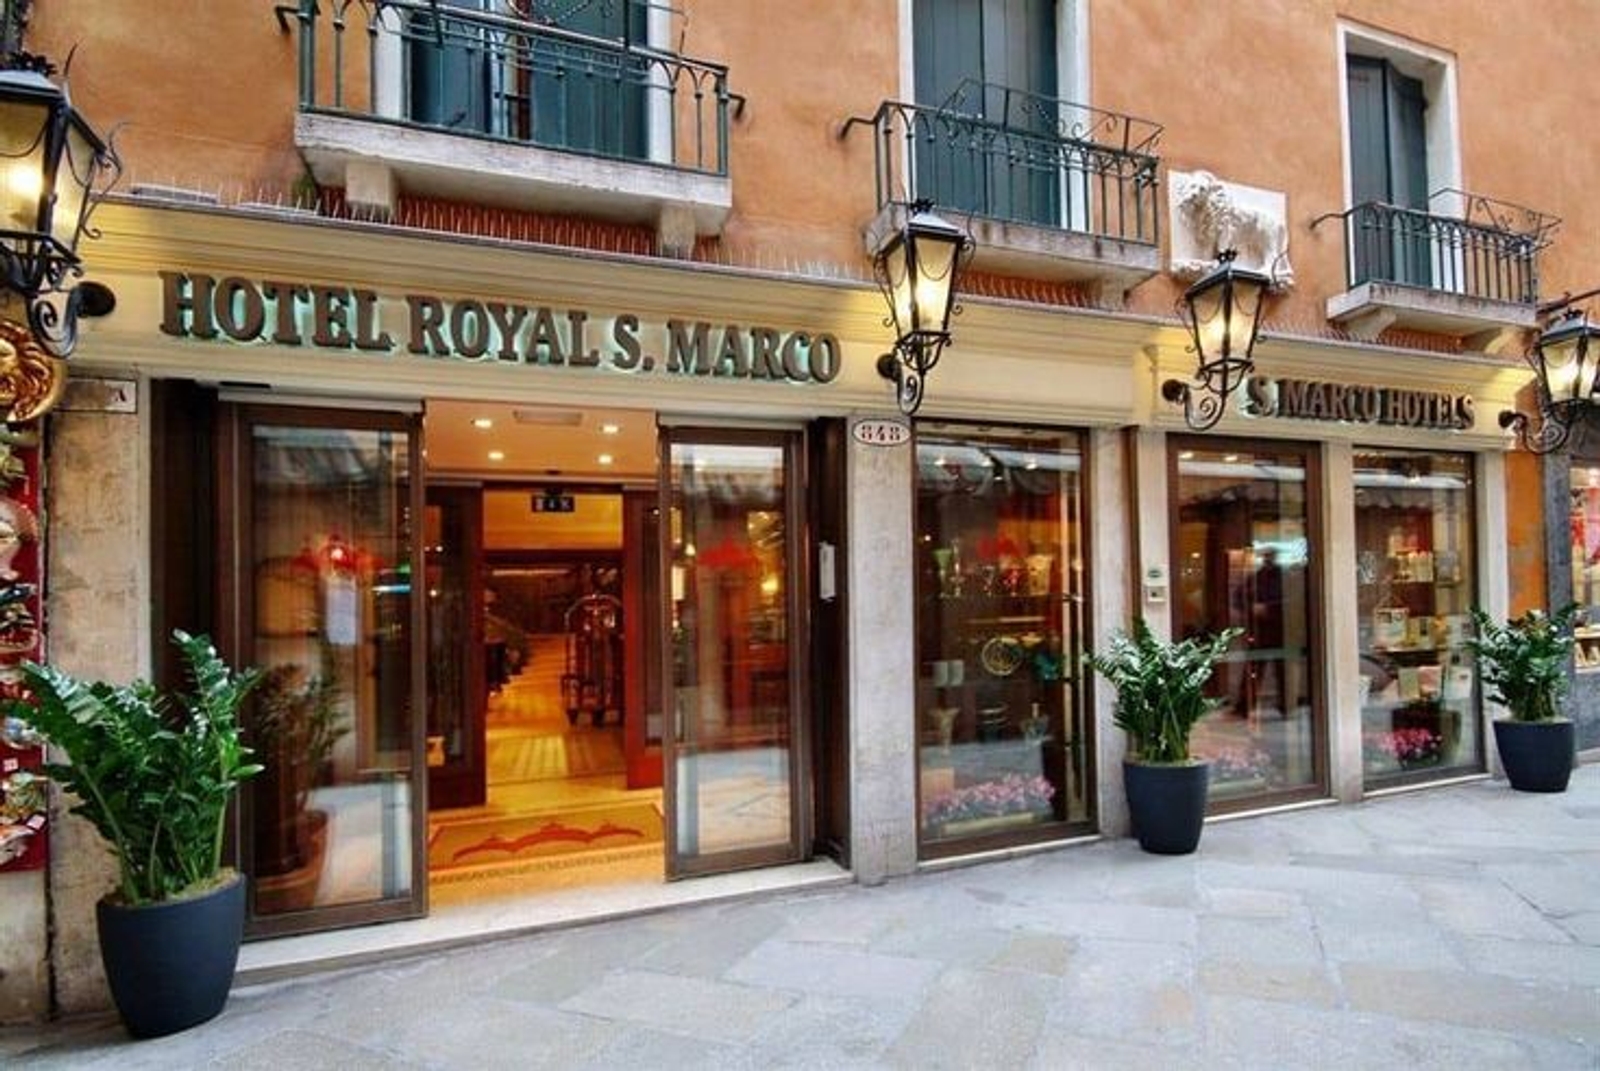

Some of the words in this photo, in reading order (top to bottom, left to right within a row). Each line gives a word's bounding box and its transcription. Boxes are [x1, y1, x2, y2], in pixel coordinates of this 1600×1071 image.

[158, 270, 393, 351] HOTEL
[406, 294, 599, 367] ROYAL
[612, 313, 655, 371] S.
[666, 319, 842, 384] MARCO
[1276, 378, 1381, 424] MARCO
[1379, 387, 1476, 431] HOTELS
[861, 424, 901, 441] 848
